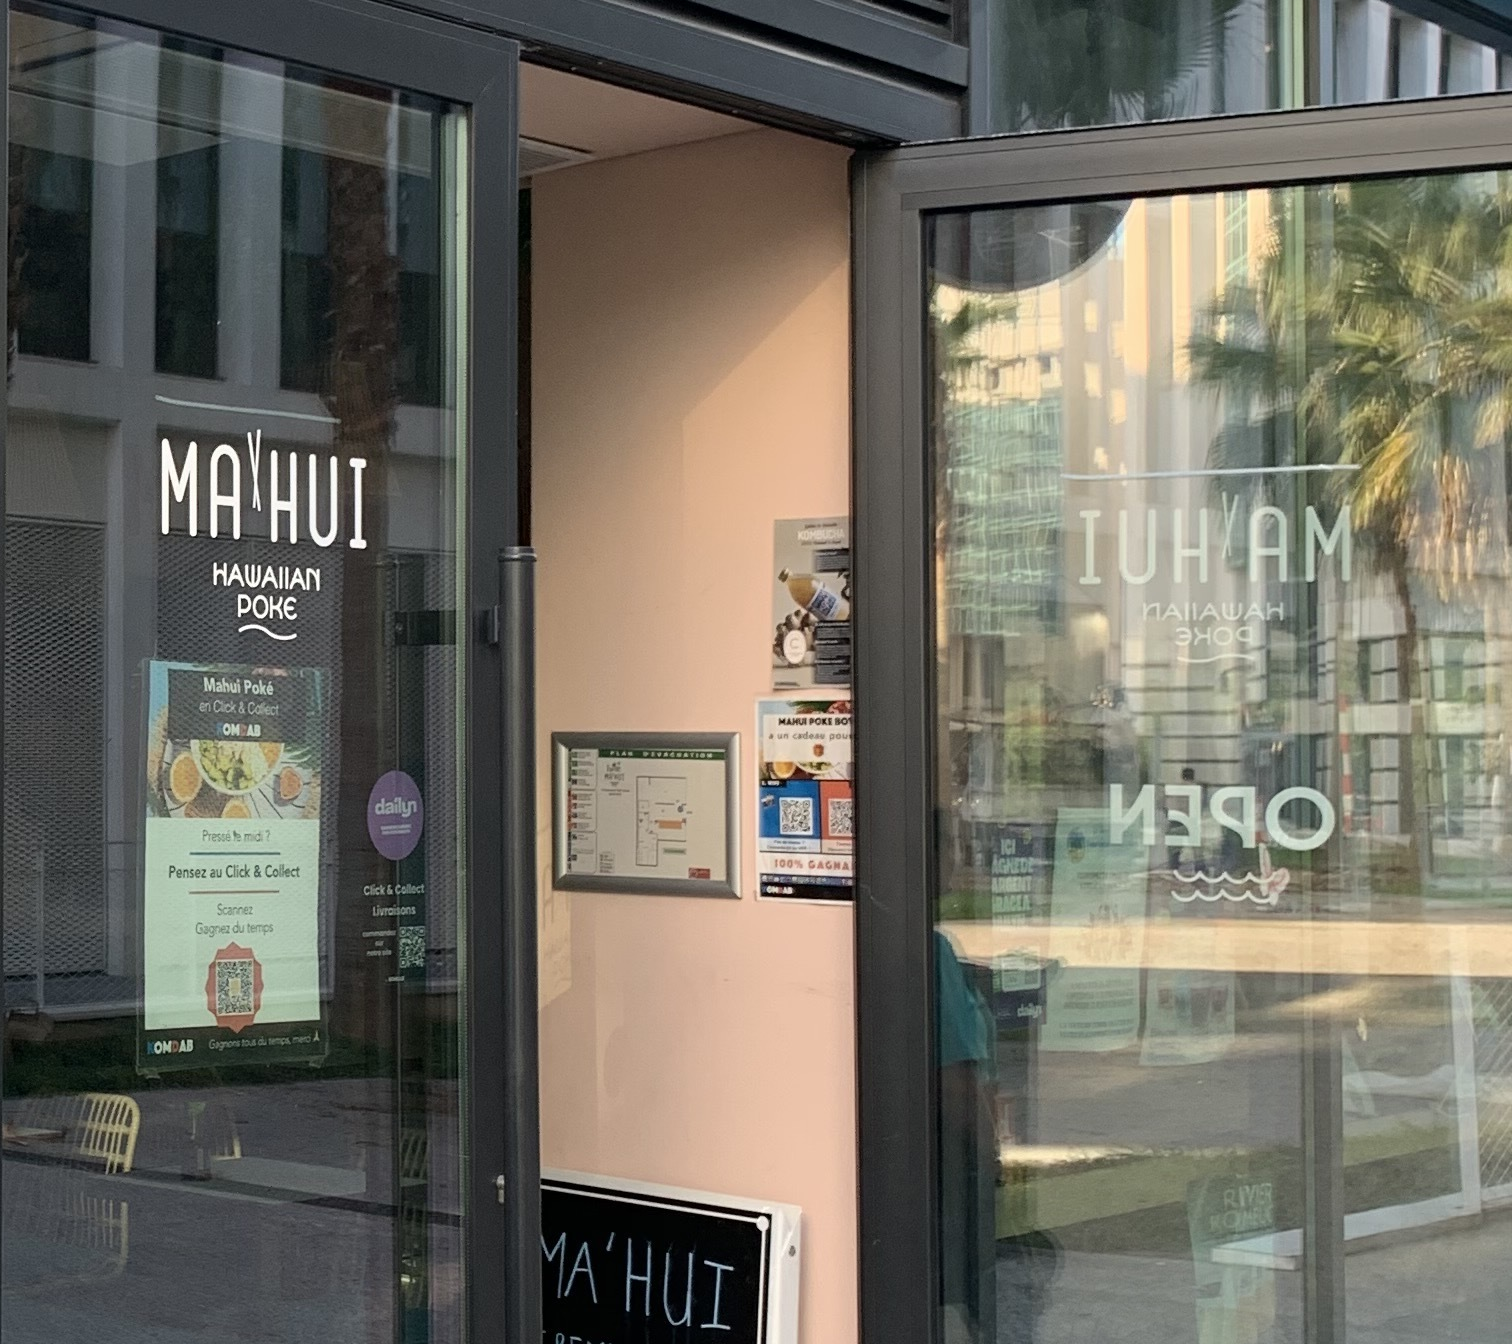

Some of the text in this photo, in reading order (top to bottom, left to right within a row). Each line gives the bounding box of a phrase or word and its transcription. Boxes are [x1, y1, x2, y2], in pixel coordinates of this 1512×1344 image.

[212, 562, 321, 592] HAWAIIAN
[237, 594, 298, 620] POKE
[203, 676, 274, 696] Mahui Poké
[213, 699, 237, 713] Click
[247, 701, 280, 716] Collect
[778, 717, 808, 726] MAHUI
[792, 731, 825, 740] cadeau
[374, 797, 418, 818] dailyn
[202, 829, 231, 843] Pressé
[243, 830, 263, 843] midi
[168, 864, 300, 879] Pensez au Click & Collect
[363, 884, 386, 896] Click
[394, 883, 425, 895] Collect
[217, 903, 253, 916] Scannez
[372, 905, 417, 917] Livraisons
[195, 921, 274, 937] Gagnez du temps
[208, 1039, 239, 1051] Gagnons
[241, 1039, 257, 1049] tous
[258, 1037, 268, 1047] du
